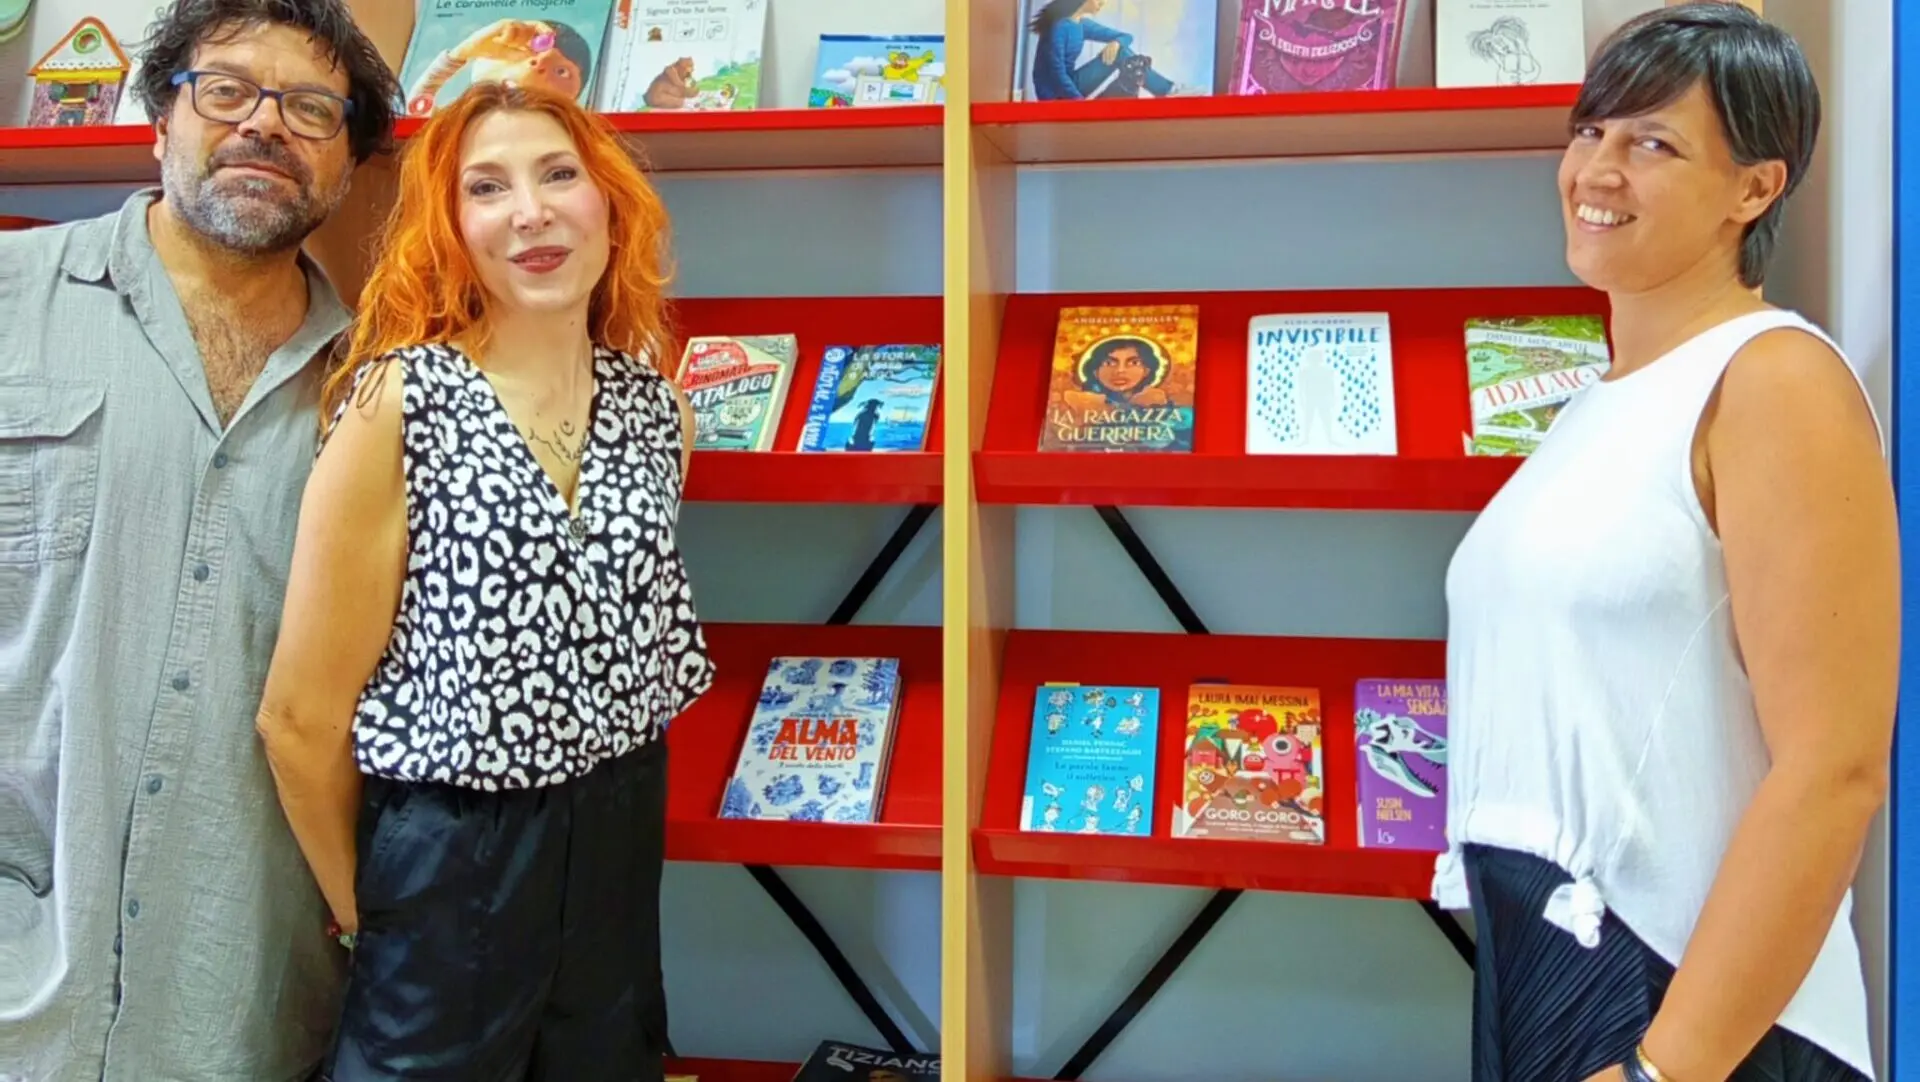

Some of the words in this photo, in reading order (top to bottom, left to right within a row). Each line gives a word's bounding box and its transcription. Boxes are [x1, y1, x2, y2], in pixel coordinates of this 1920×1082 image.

[1256, 327, 1382, 347] INVISIBILE
[685, 374, 774, 408] ATALOGO
[1053, 408, 1074, 429] LA
[1083, 408, 1183, 426] RAGAZZA
[1057, 425, 1175, 445] GUERRIERA
[1198, 693, 1230, 704] LAURA
[1262, 695, 1309, 706] MESSINA
[1377, 684, 1391, 697] LA
[1393, 684, 1413, 697] MIA
[1415, 684, 1440, 698] VITA
[772, 719, 858, 745] ALMA
[768, 746, 798, 760] DEL
[804, 746, 856, 761] VENTO
[1205, 808, 1250, 821] GORO
[1254, 809, 1300, 823] GORO
